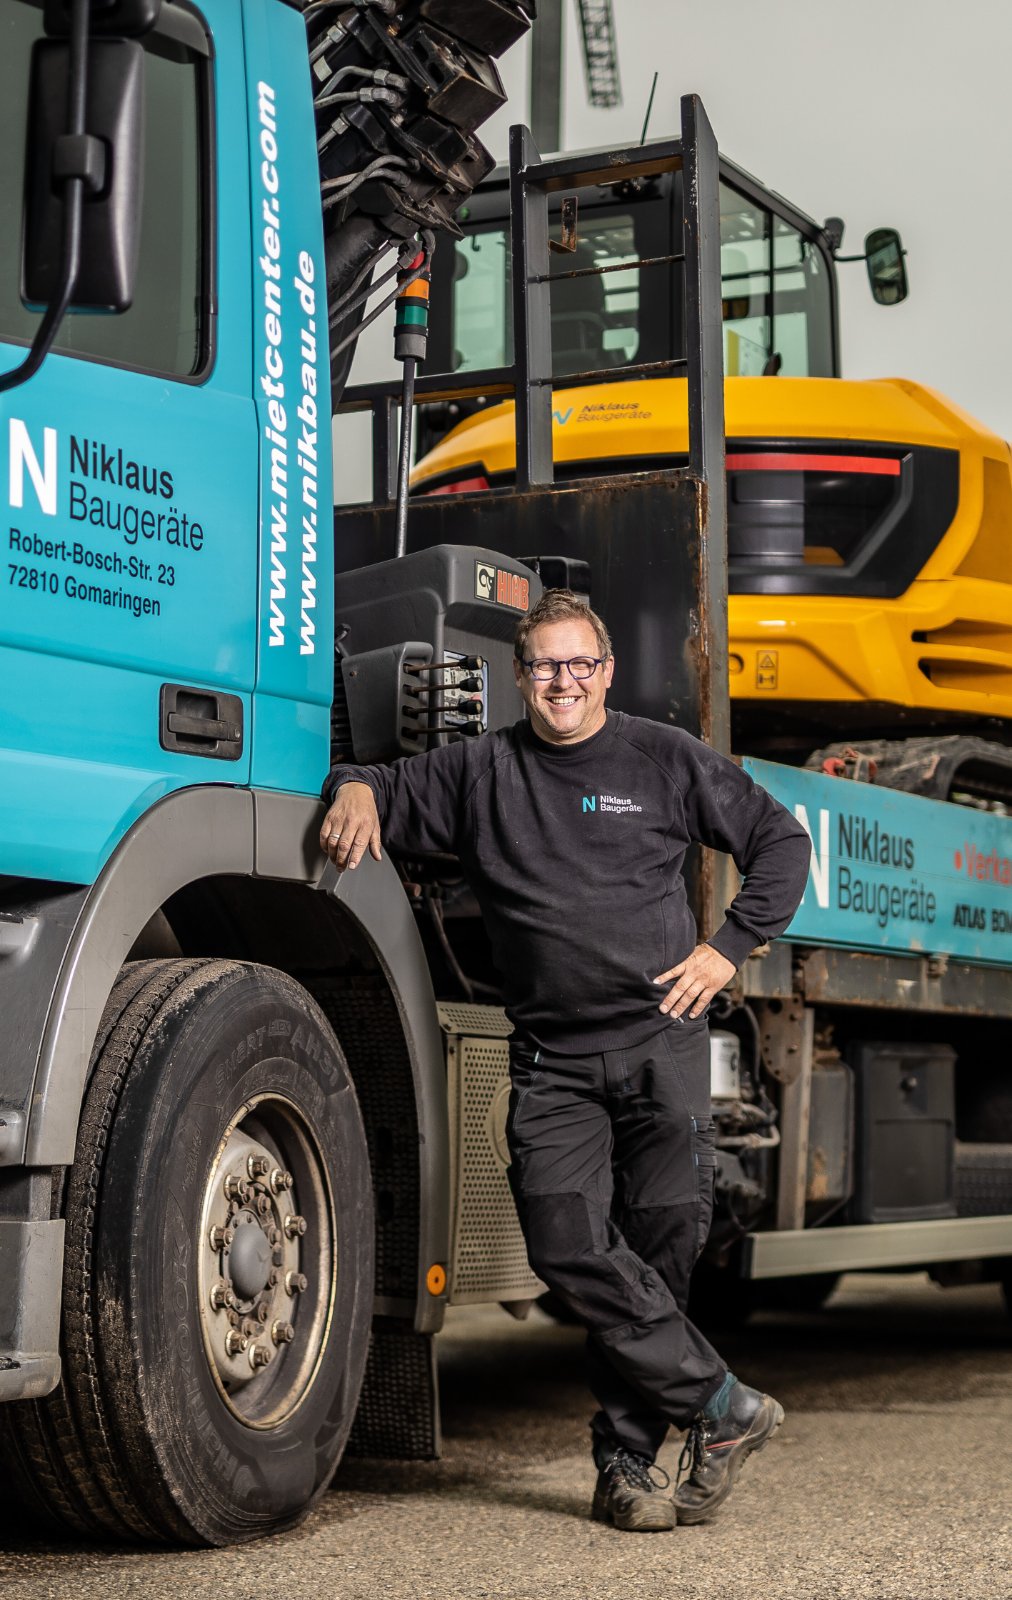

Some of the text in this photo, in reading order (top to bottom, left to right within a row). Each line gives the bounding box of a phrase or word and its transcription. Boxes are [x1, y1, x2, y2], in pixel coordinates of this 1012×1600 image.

[257, 81, 288, 647] www.mietcenter.com
[582, 403, 640, 413] Niklaus
[9, 417, 57, 516] N
[70, 434, 174, 499] Niklaus
[294, 250, 318, 655] www.nikbau.de
[69, 481, 204, 551] Baugeräte
[9, 527, 175, 586] Robert-Bosch-Str. 23
[8, 563, 161, 618] 72810 Gomaringen
[497, 569, 529, 612] HIAB
[582, 795, 596, 813] N
[600, 795, 632, 805] Niklaus
[795, 804, 829, 909] N
[838, 813, 914, 869] Niklaus
[838, 865, 936, 928] Baugeräte
[953, 903, 986, 931] ATLAS
